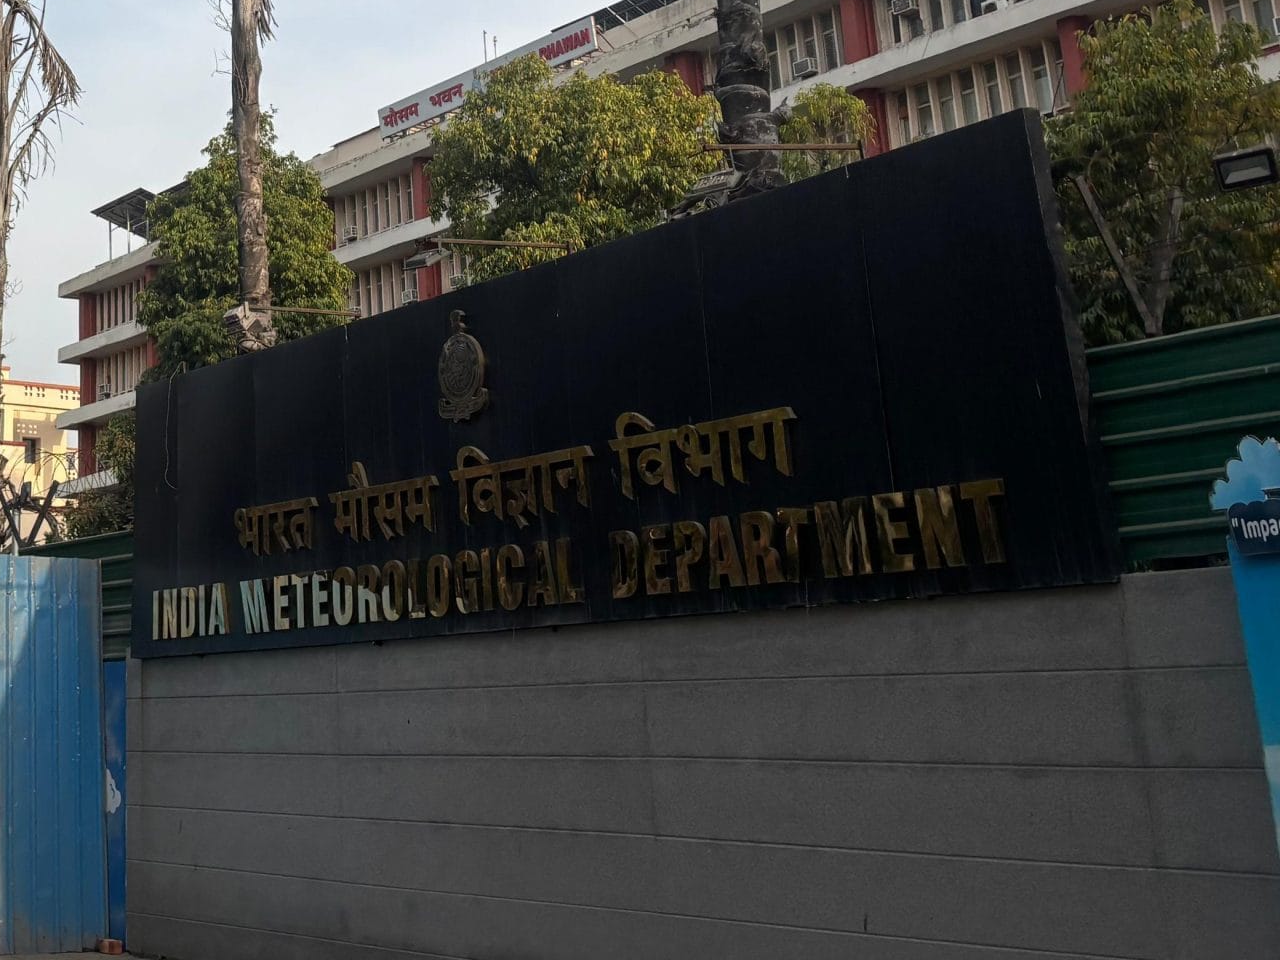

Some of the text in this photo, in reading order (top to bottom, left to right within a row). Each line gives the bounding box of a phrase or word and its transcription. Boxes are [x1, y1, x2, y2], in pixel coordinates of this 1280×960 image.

[428, 83, 464, 107] भवन
[234, 406, 798, 556] भारत मौसम विज्ञान विभाग
[152, 478, 1006, 640] INDIA METEOROLOGICAL DEPARTMENT
[1231, 517, 1280, 542] "Impa
